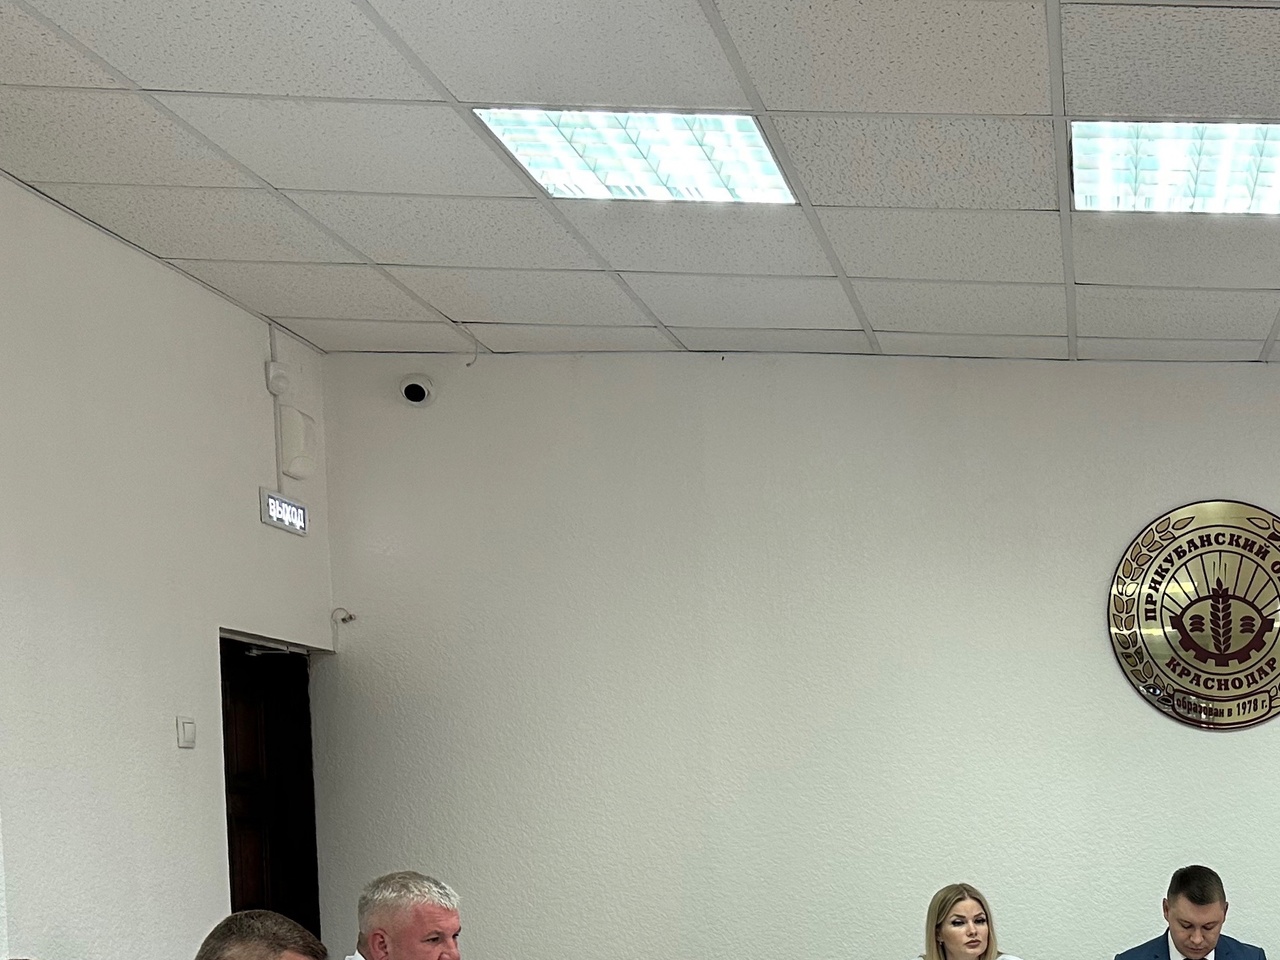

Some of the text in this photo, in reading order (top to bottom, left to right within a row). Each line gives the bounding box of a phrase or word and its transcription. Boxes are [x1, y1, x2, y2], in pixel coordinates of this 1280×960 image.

[268, 498, 305, 530] ВЫХОД
[1144, 531, 1271, 622] ПРИКУБАНСКИЙ
[1165, 656, 1278, 692] КРАСНОДАР
[1176, 696, 1268, 718] образован в 1978 г.
